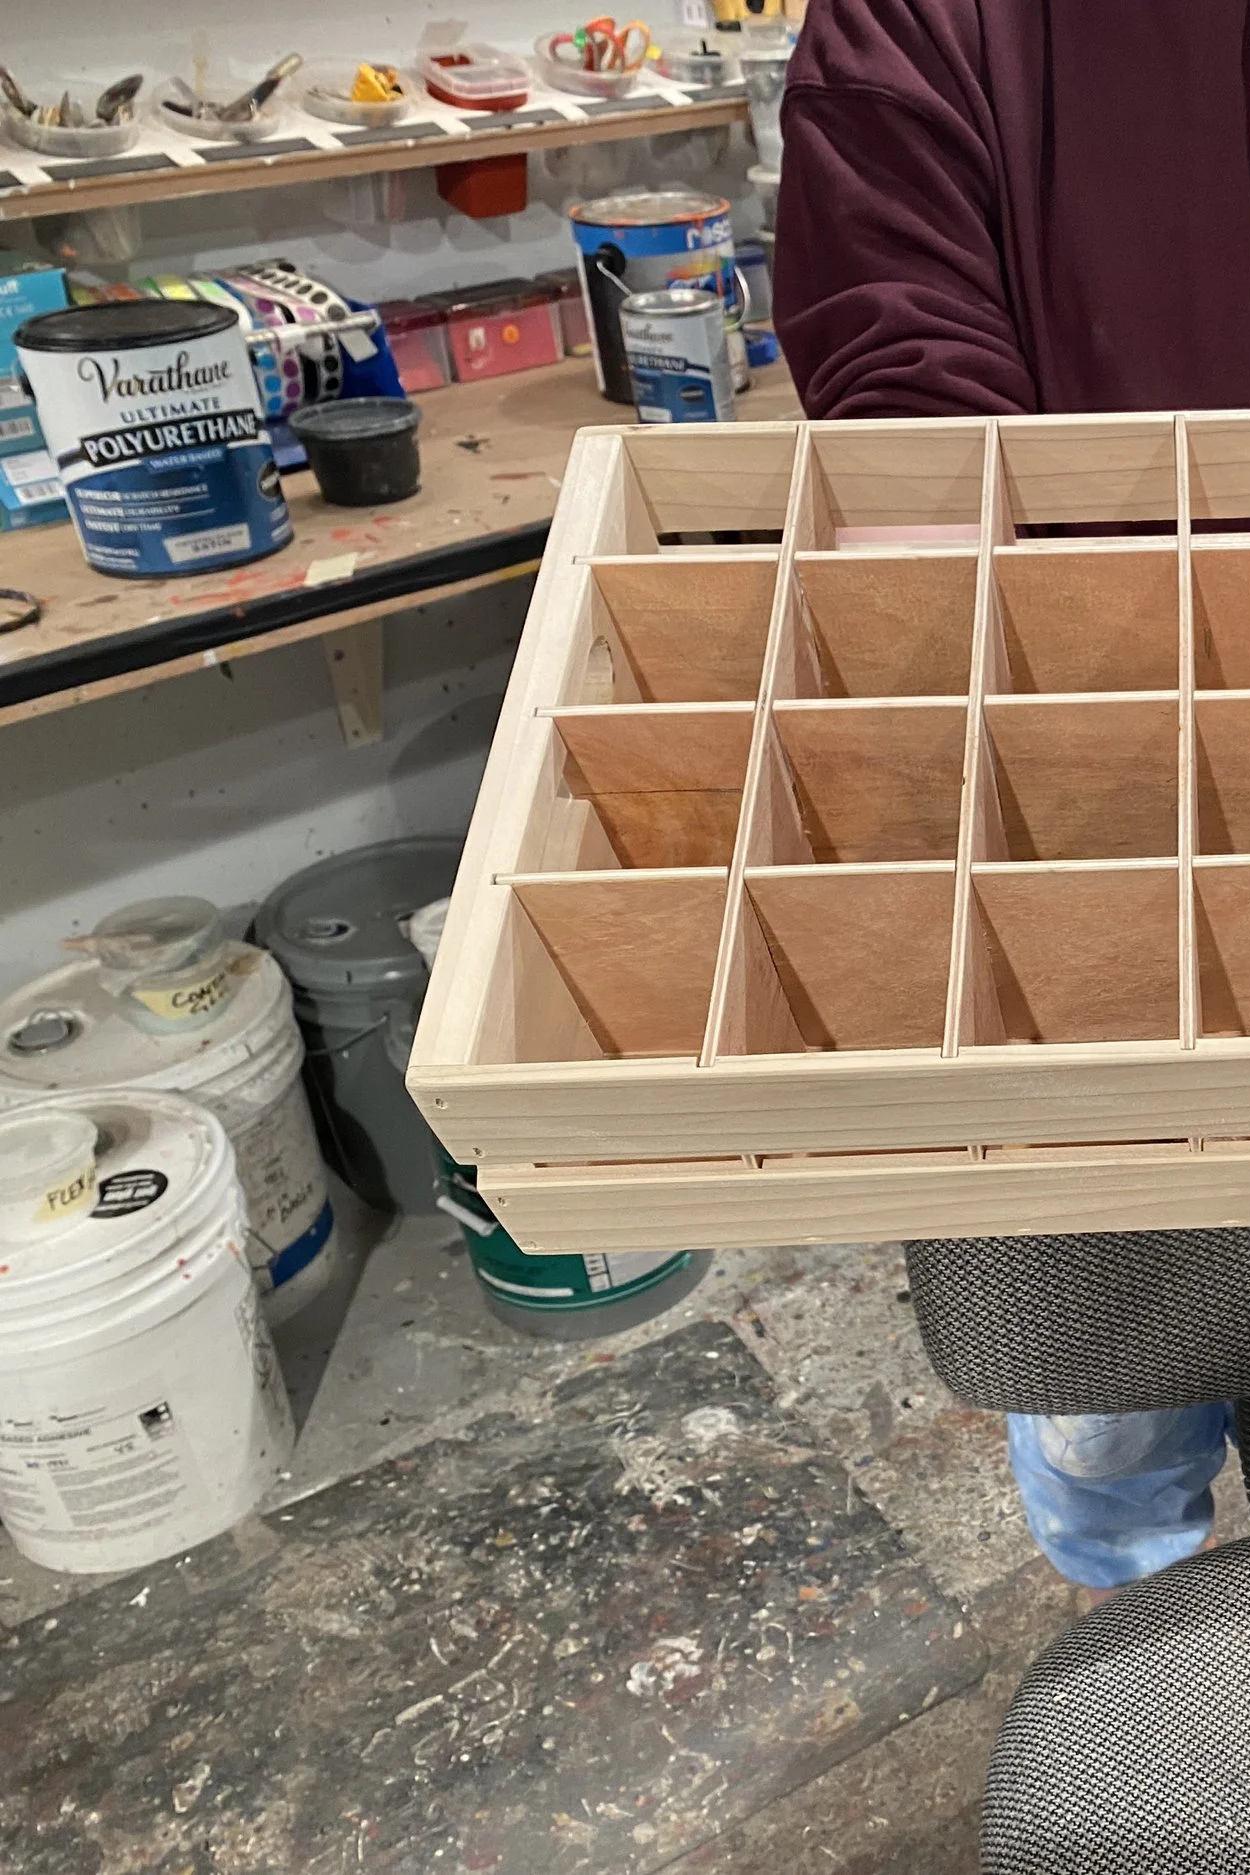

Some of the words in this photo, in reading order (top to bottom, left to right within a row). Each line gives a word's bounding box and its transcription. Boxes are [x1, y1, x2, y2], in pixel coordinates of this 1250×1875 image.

[77, 350, 231, 403] Varathane
[120, 397, 220, 424] ULTIMATE
[83, 412, 256, 463] POLYURETHANE
